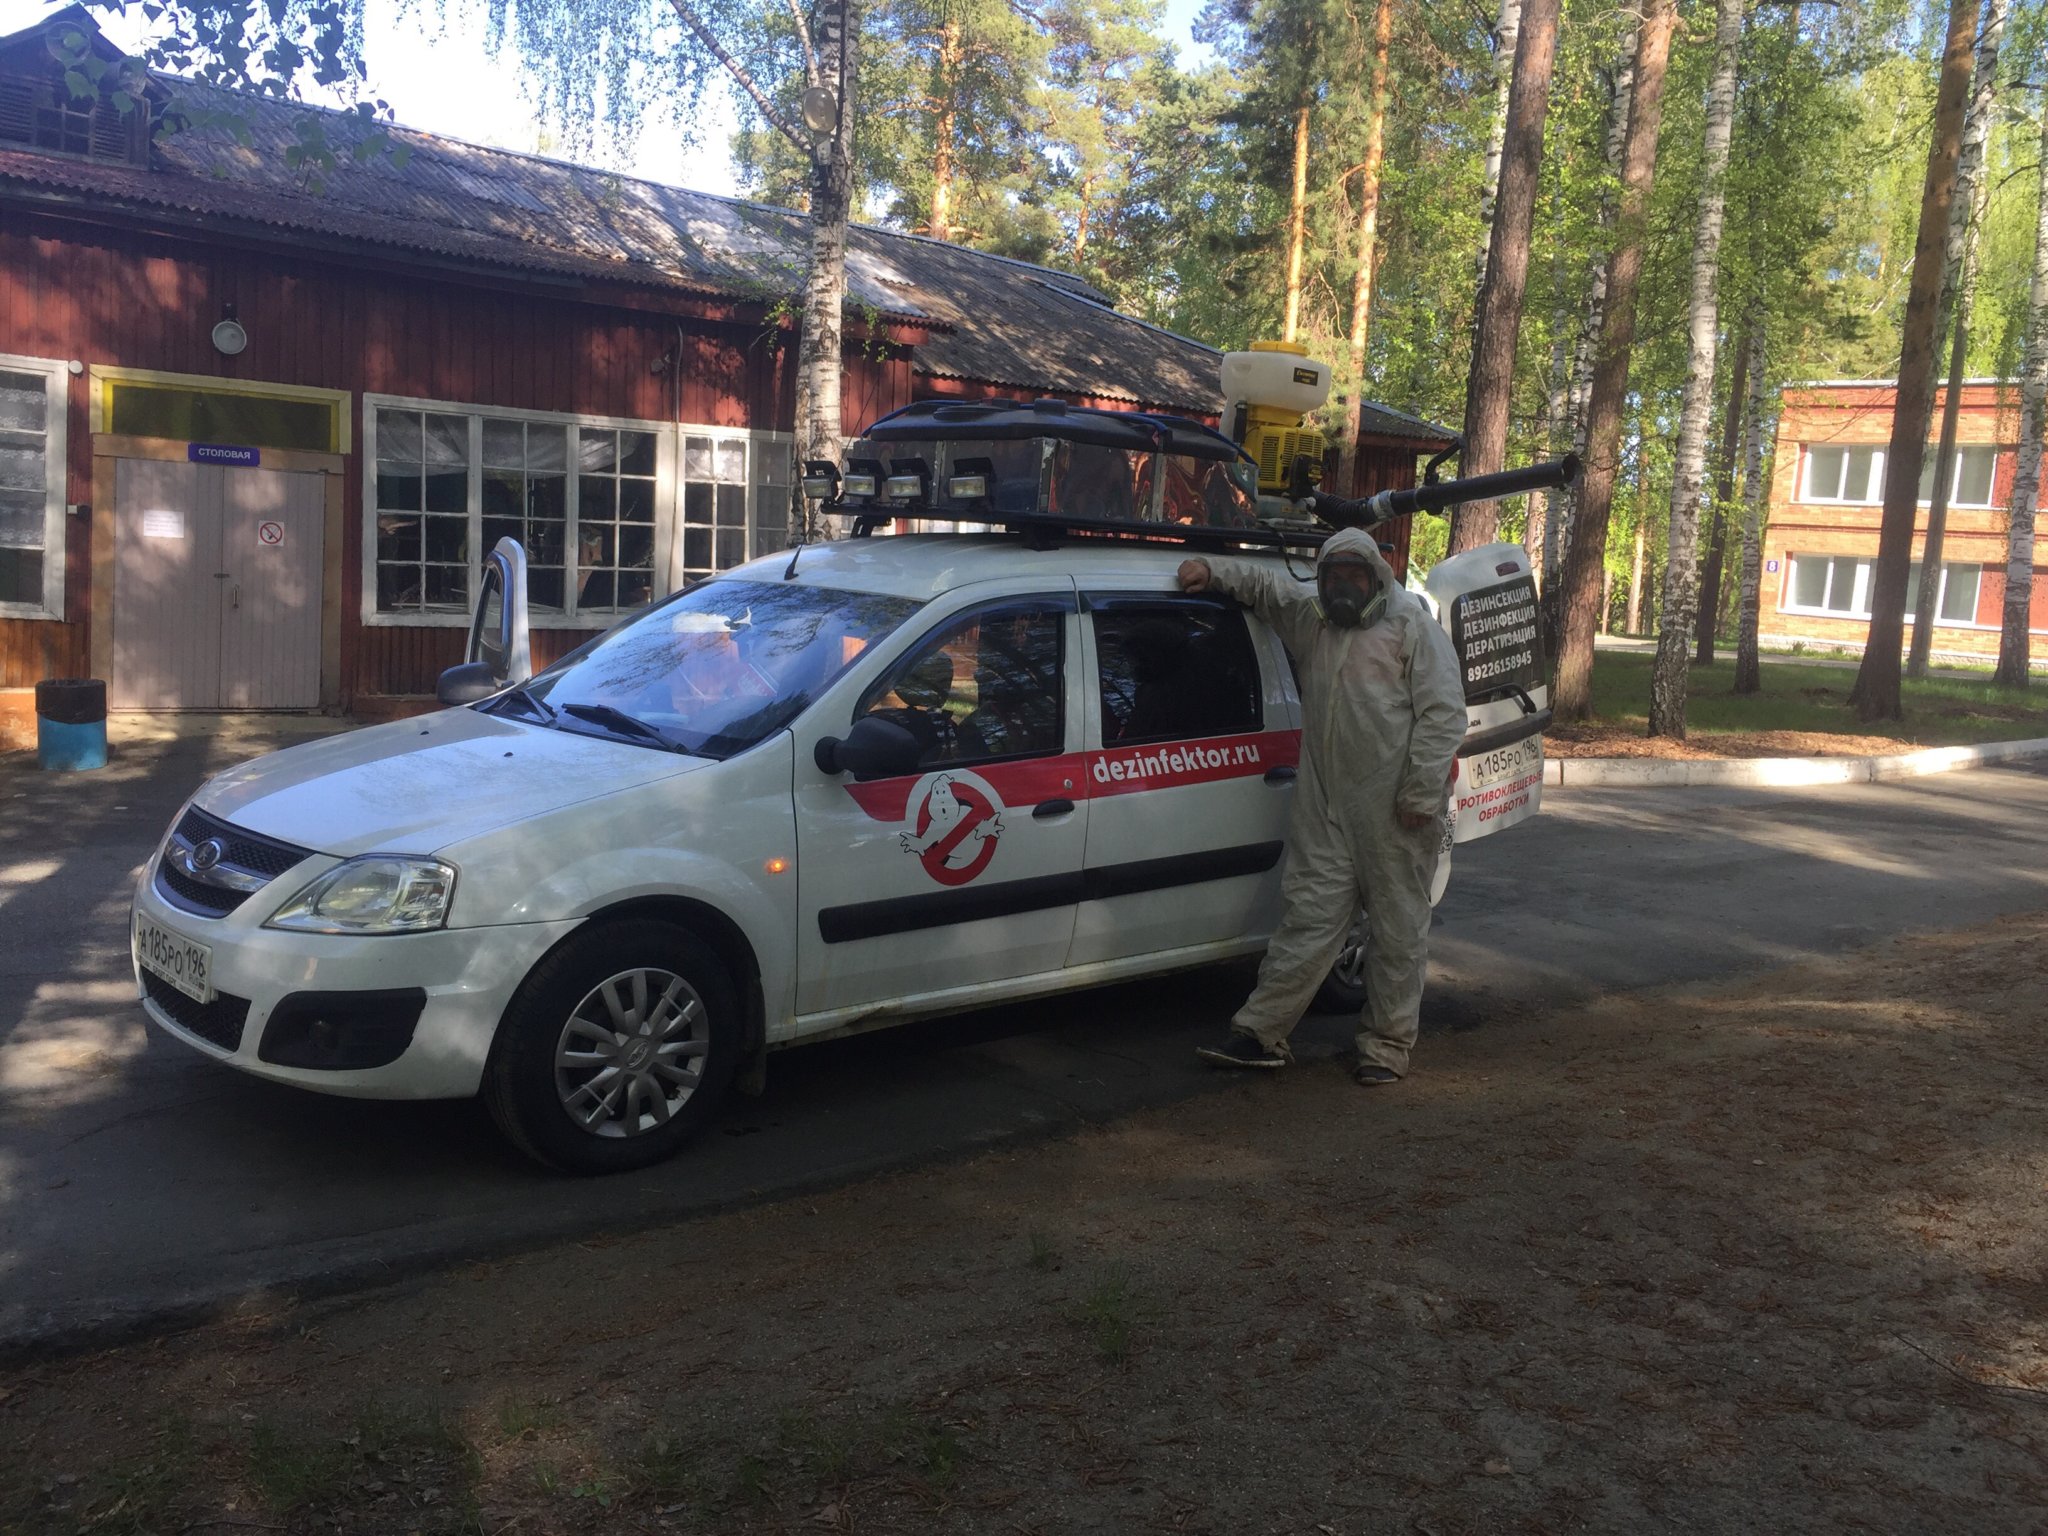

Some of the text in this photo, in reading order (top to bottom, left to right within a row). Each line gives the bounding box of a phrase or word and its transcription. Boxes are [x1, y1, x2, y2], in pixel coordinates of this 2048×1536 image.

[198, 447, 251, 460] СТОЛОВАЯ
[1768, 561, 1776, 572] 8
[1460, 586, 1532, 620] ДЕЗИНСЕКЦИЯ
[1463, 605, 1536, 640] ДЕЗИНФЕКЦИЯ
[1466, 625, 1537, 661] ДЕРАТИЗАЦИЯ
[1467, 650, 1532, 682] 89226158945
[1093, 744, 1261, 783] dezinfektor.ru
[1478, 793, 1529, 822] ОБРАБОТКИ
